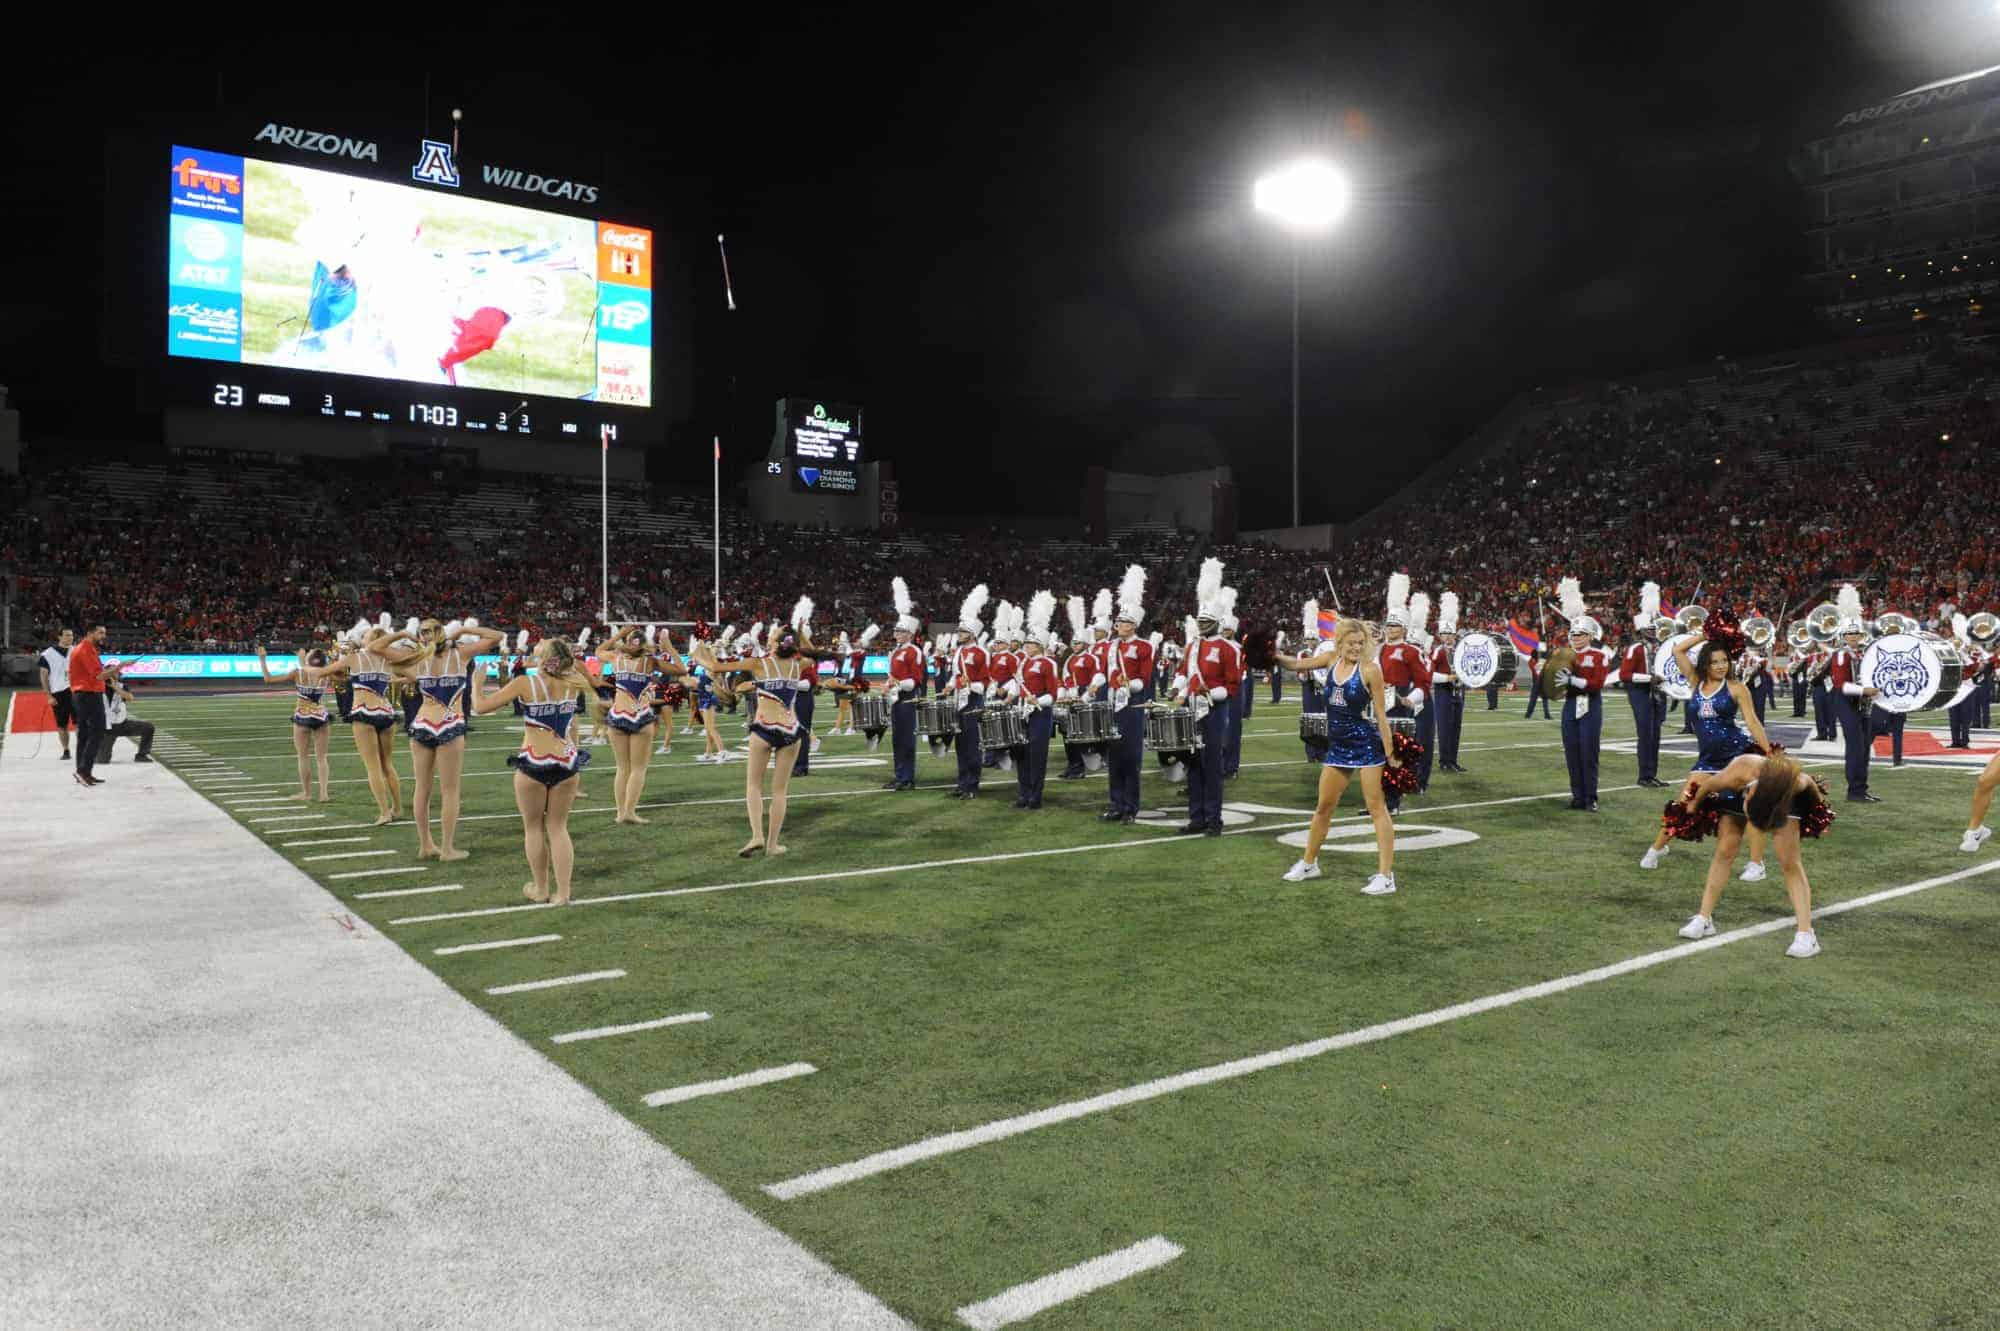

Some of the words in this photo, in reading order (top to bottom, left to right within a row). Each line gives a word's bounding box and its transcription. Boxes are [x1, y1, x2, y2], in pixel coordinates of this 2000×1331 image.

[1834, 82, 1968, 127] ARIZONA
[254, 122, 378, 162] ARIZONA
[412, 140, 460, 187] A
[483, 165, 599, 203] WILDCATS
[214, 384, 243, 406] 23
[324, 395, 333, 407] 3
[409, 404, 457, 426] 17:03
[499, 412, 507, 424] 3
[520, 414, 529, 426] 3
[601, 423, 617, 440] 14
[767, 462, 781, 473] 25
[823, 469, 853, 478] DESERT
[820, 475, 857, 484] DIAMOND
[1329, 687, 1348, 706] A
